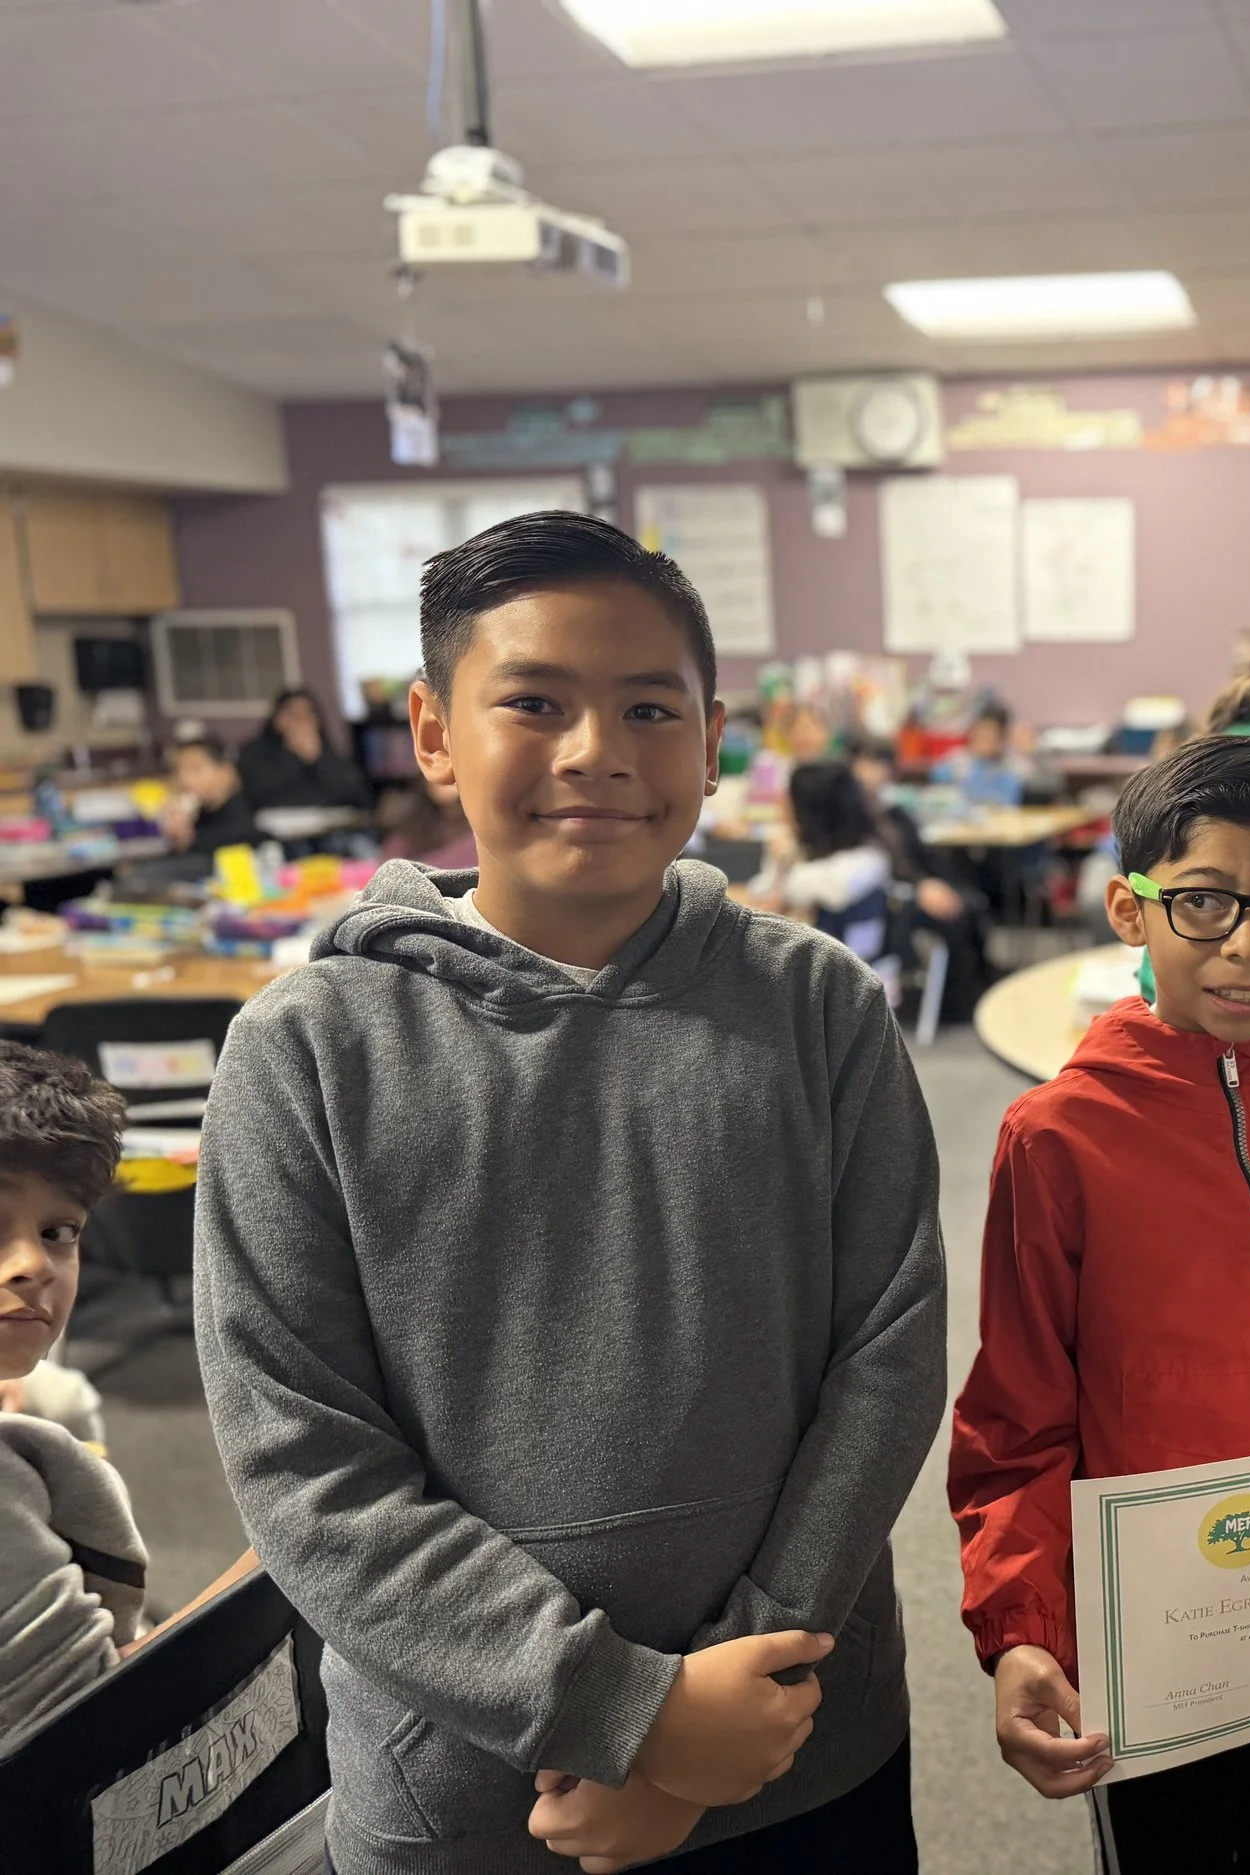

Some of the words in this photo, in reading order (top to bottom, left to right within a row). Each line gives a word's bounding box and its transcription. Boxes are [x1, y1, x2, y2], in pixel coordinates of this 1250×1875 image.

[1165, 1688, 1197, 1701] Anna
[1199, 1680, 1230, 1694] Chan
[1172, 1701, 1189, 1711] MEF
[1190, 1694, 1223, 1708] President
[157, 1710, 258, 1829] MAX
